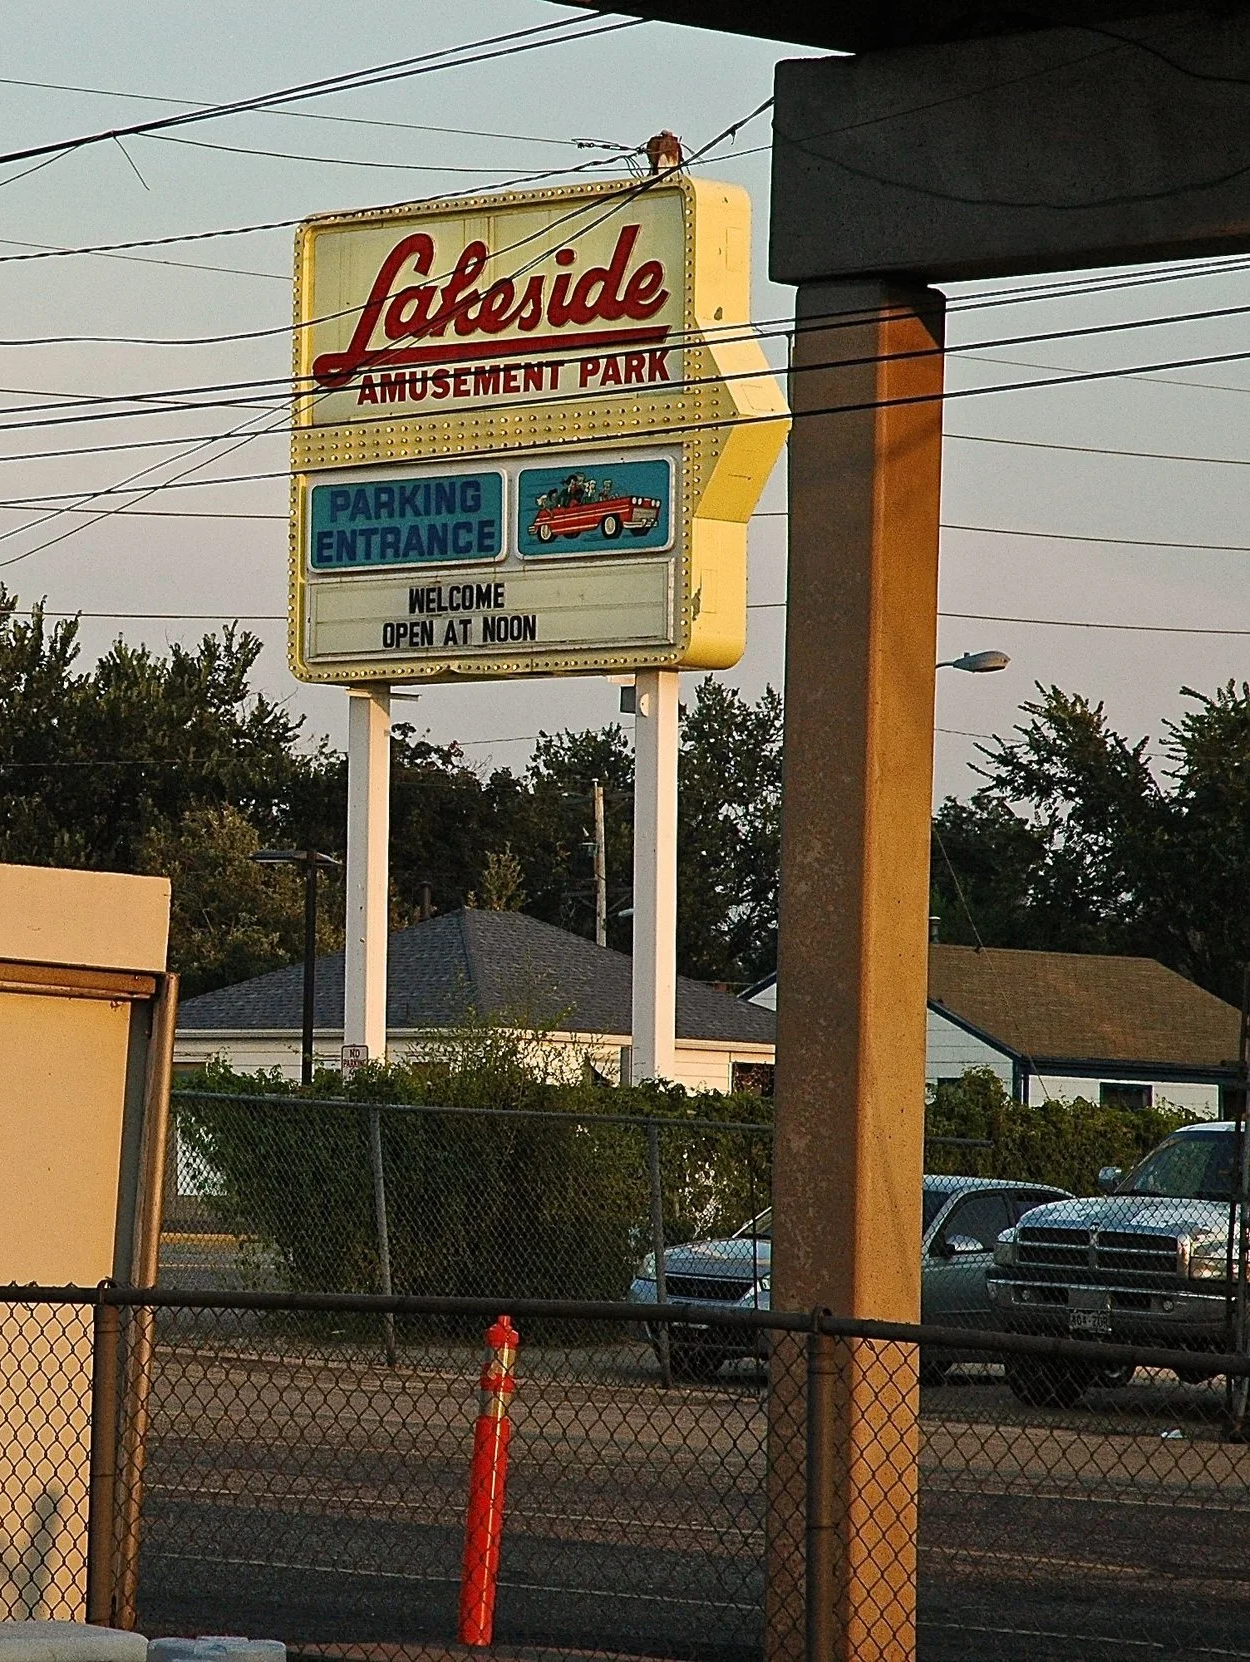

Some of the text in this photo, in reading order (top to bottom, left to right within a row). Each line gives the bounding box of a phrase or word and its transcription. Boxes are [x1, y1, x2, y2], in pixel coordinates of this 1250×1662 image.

[313, 224, 671, 387] Lakeside
[357, 350, 671, 405] AMUSEMENT PARK
[330, 481, 481, 522] PARKING
[317, 520, 495, 563] ENTRANCE
[409, 583, 505, 614] WELCOME
[383, 615, 537, 648] OPEN AT NOON
[349, 1049, 361, 1058] NO
